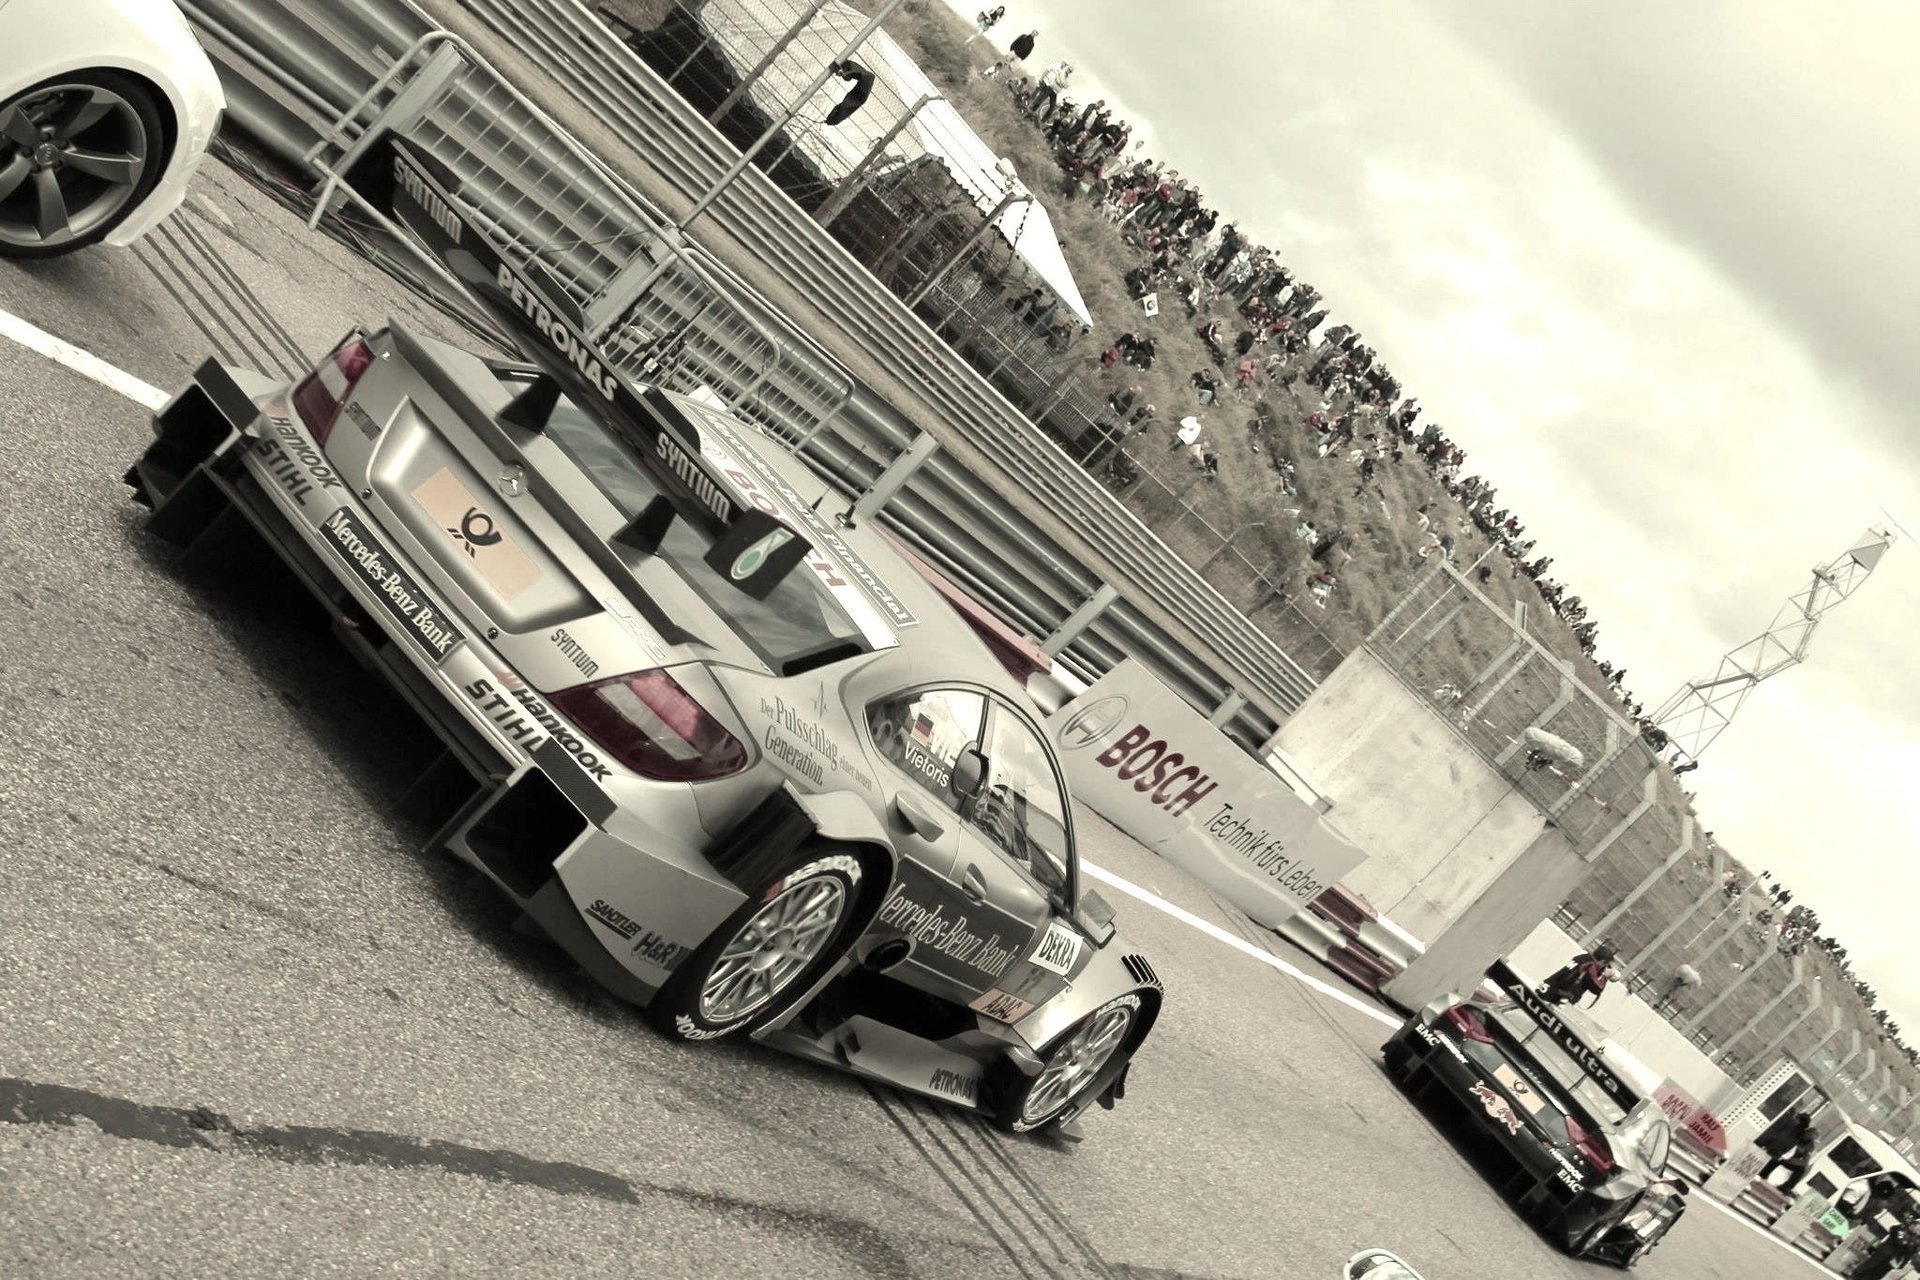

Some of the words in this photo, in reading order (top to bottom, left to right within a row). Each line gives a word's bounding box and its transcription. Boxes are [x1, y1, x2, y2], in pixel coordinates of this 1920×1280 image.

[393, 155, 463, 245] SYNTIUM
[499, 263, 618, 401] PETRONAS
[255, 438, 316, 507] STIHL
[655, 431, 731, 524] SYNTIUM
[706, 413, 824, 531] Mercedes-Benz
[821, 532, 910, 621] Financial
[724, 468, 848, 587] BOH
[325, 509, 419, 614] Mercedes-Benz
[410, 605, 456, 655] Bank
[550, 628, 599, 679] SYNTIUM
[464, 678, 552, 752] STIHL
[774, 695, 839, 772] Pulsschlag
[902, 741, 950, 788] Vietoris
[1094, 723, 1219, 818] BOSCH
[1203, 803, 1268, 860] Technik
[1251, 840, 1291, 876] fürs
[1278, 861, 1323, 900] Leben
[589, 899, 642, 936] SANDTLER
[967, 933, 1020, 978] Bank
[1038, 930, 1077, 970] DEKRA
[981, 994, 1023, 1020] ADAC
[1508, 983, 1562, 1034] Audi
[1564, 1036, 1619, 1094] ultra
